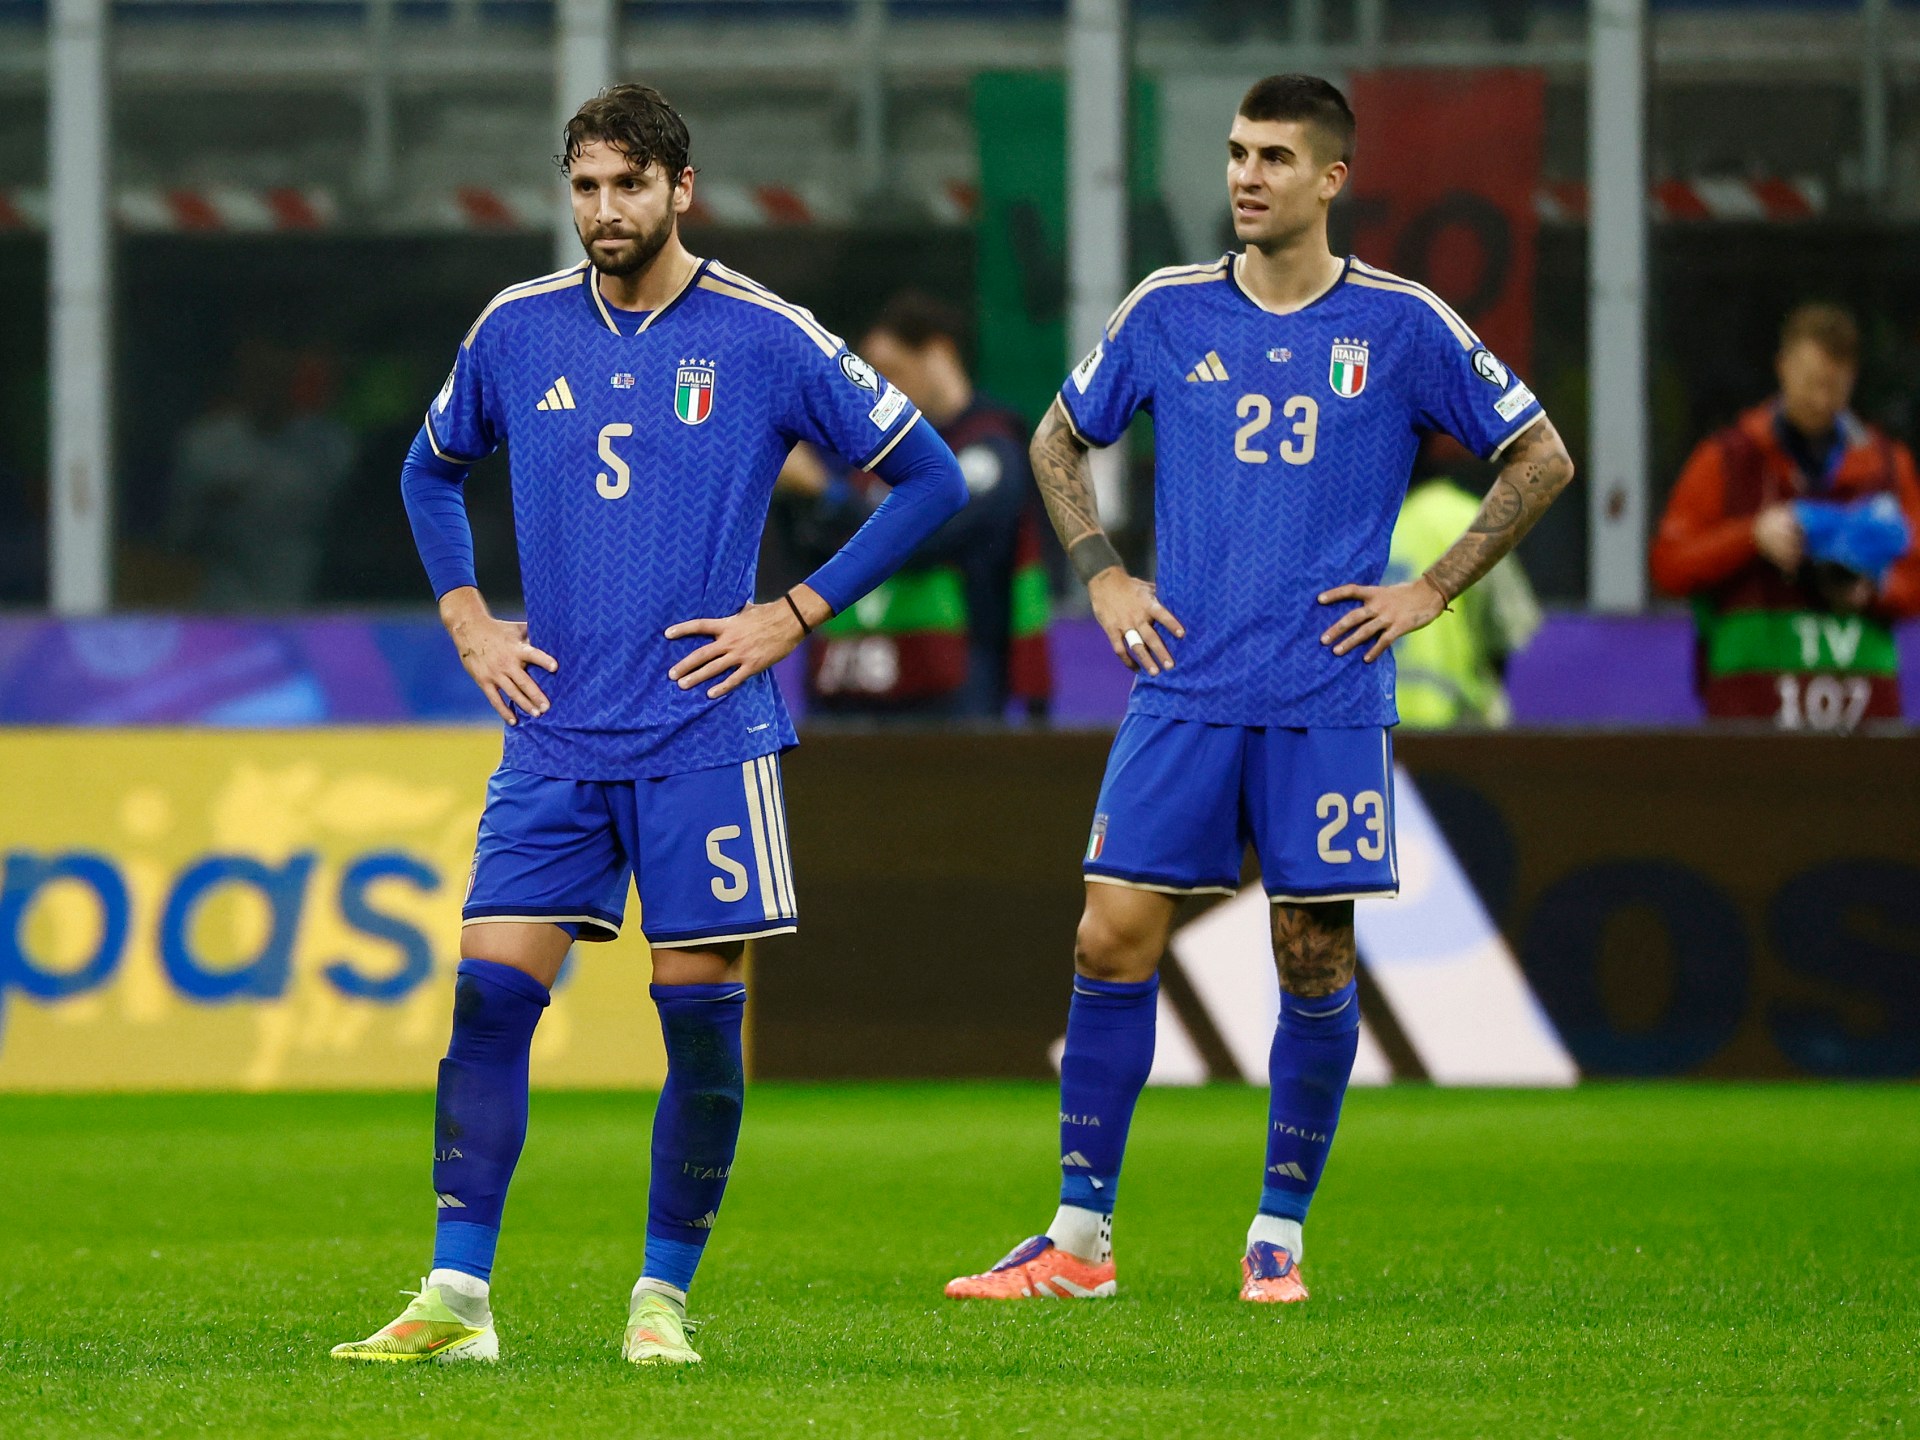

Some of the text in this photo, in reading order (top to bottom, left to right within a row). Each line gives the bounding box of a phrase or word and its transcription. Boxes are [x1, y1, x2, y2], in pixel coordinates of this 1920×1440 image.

[1334, 349, 1365, 362] ITALIA
[680, 371, 711, 384] ITALIA
[1234, 393, 1319, 466] 23
[1792, 615, 1863, 668] TV
[1316, 790, 1385, 864] 23
[1273, 1120, 1326, 1144] ITALIA
